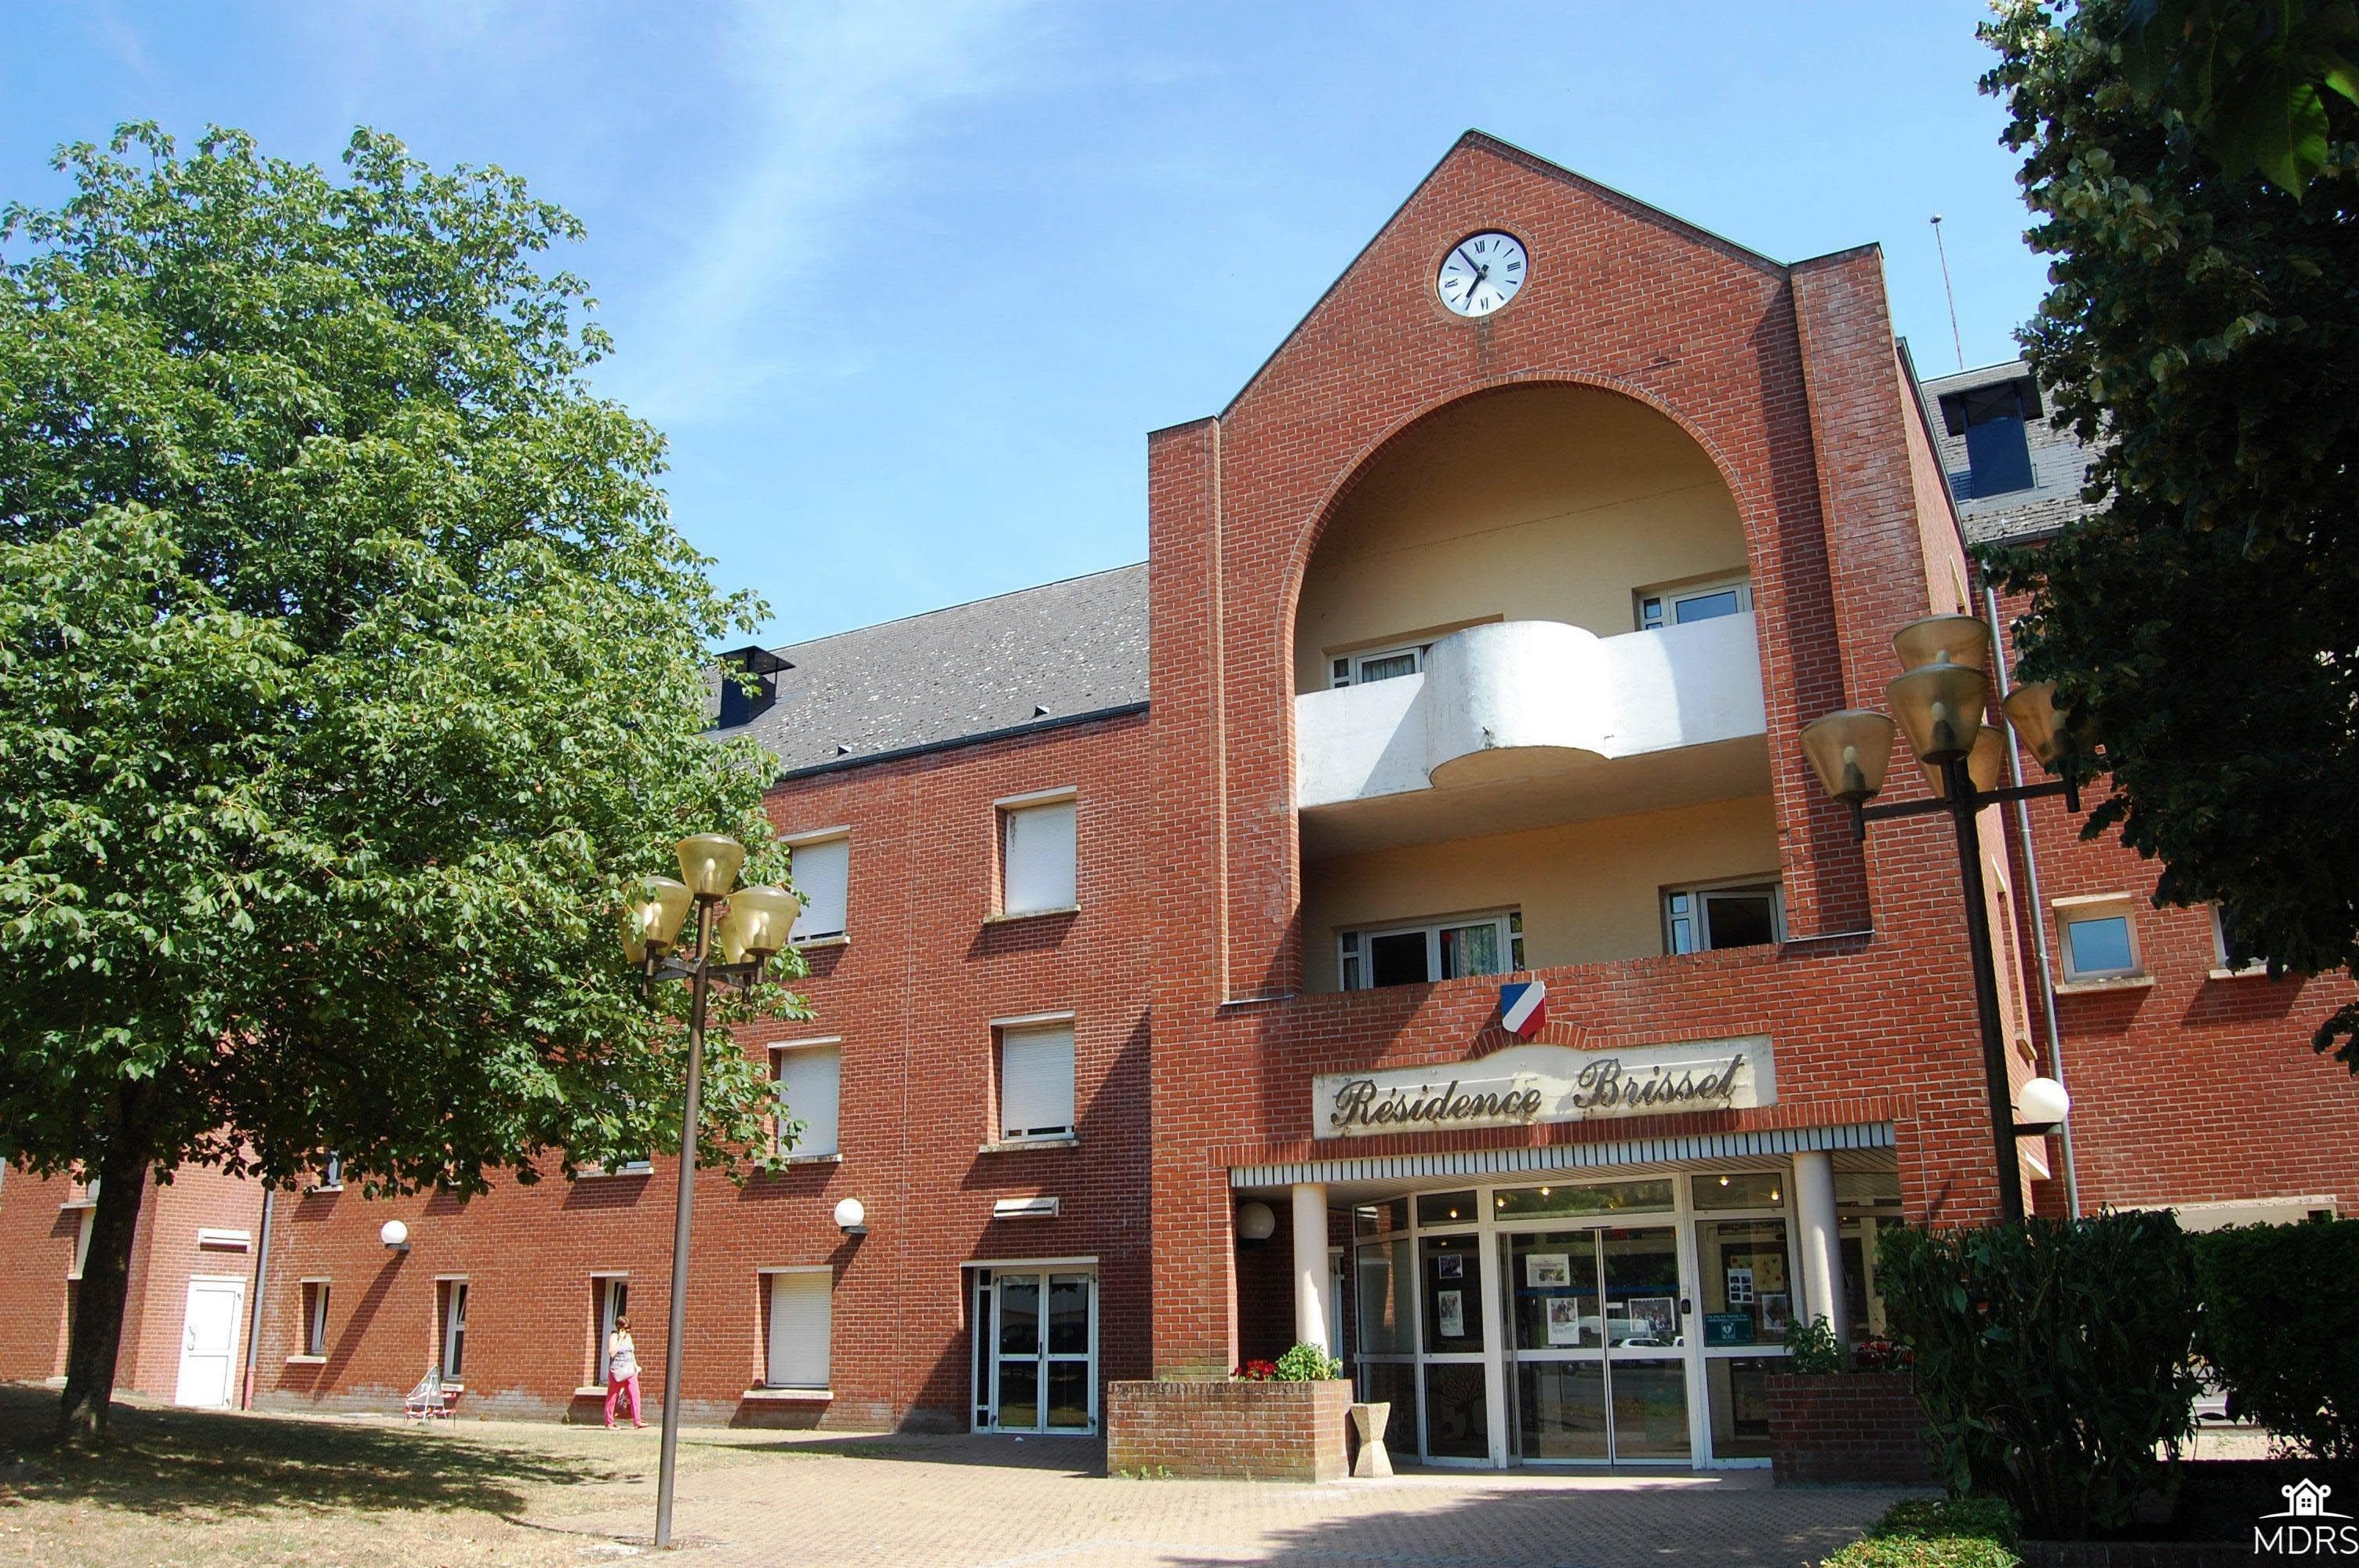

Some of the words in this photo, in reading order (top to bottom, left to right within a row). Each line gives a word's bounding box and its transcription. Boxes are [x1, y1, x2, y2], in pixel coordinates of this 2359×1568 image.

[1474, 240, 1485, 254] XII
[1507, 261, 1521, 272] III
[1330, 1079, 1543, 1127] Résidence
[1572, 1053, 1745, 1109] Brisset
